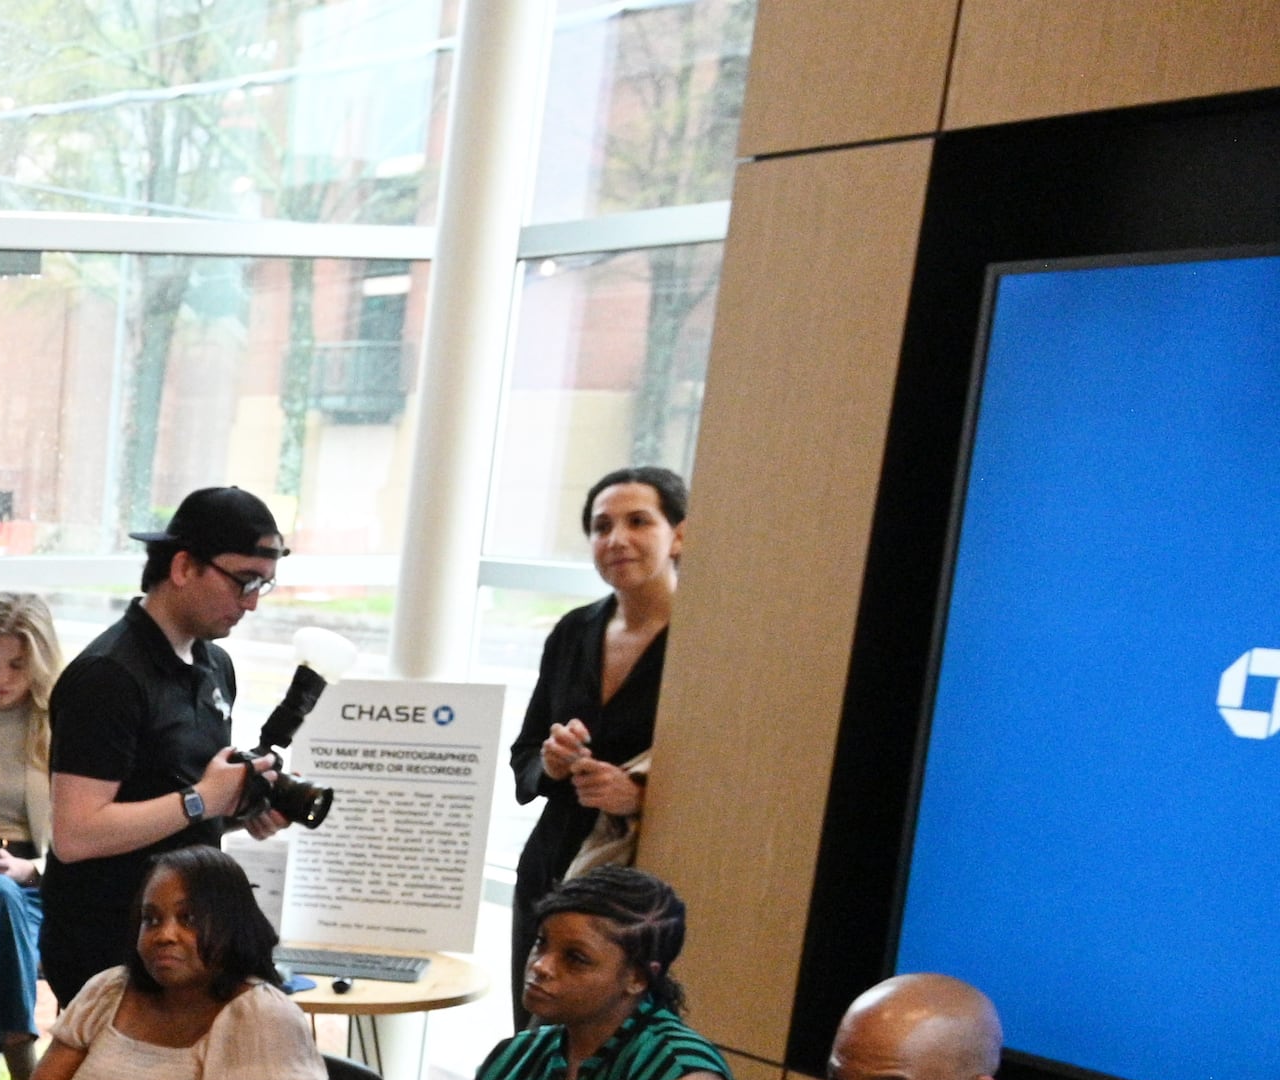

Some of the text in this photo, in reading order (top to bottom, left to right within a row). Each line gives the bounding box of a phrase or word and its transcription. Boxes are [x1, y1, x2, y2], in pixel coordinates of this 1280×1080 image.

[341, 704, 427, 723] CHASE
[310, 747, 332, 757] YOU
[335, 748, 359, 758] MAY
[362, 749, 376, 758] BE
[314, 760, 472, 776] VIDEOTAPED OR RECORDED
